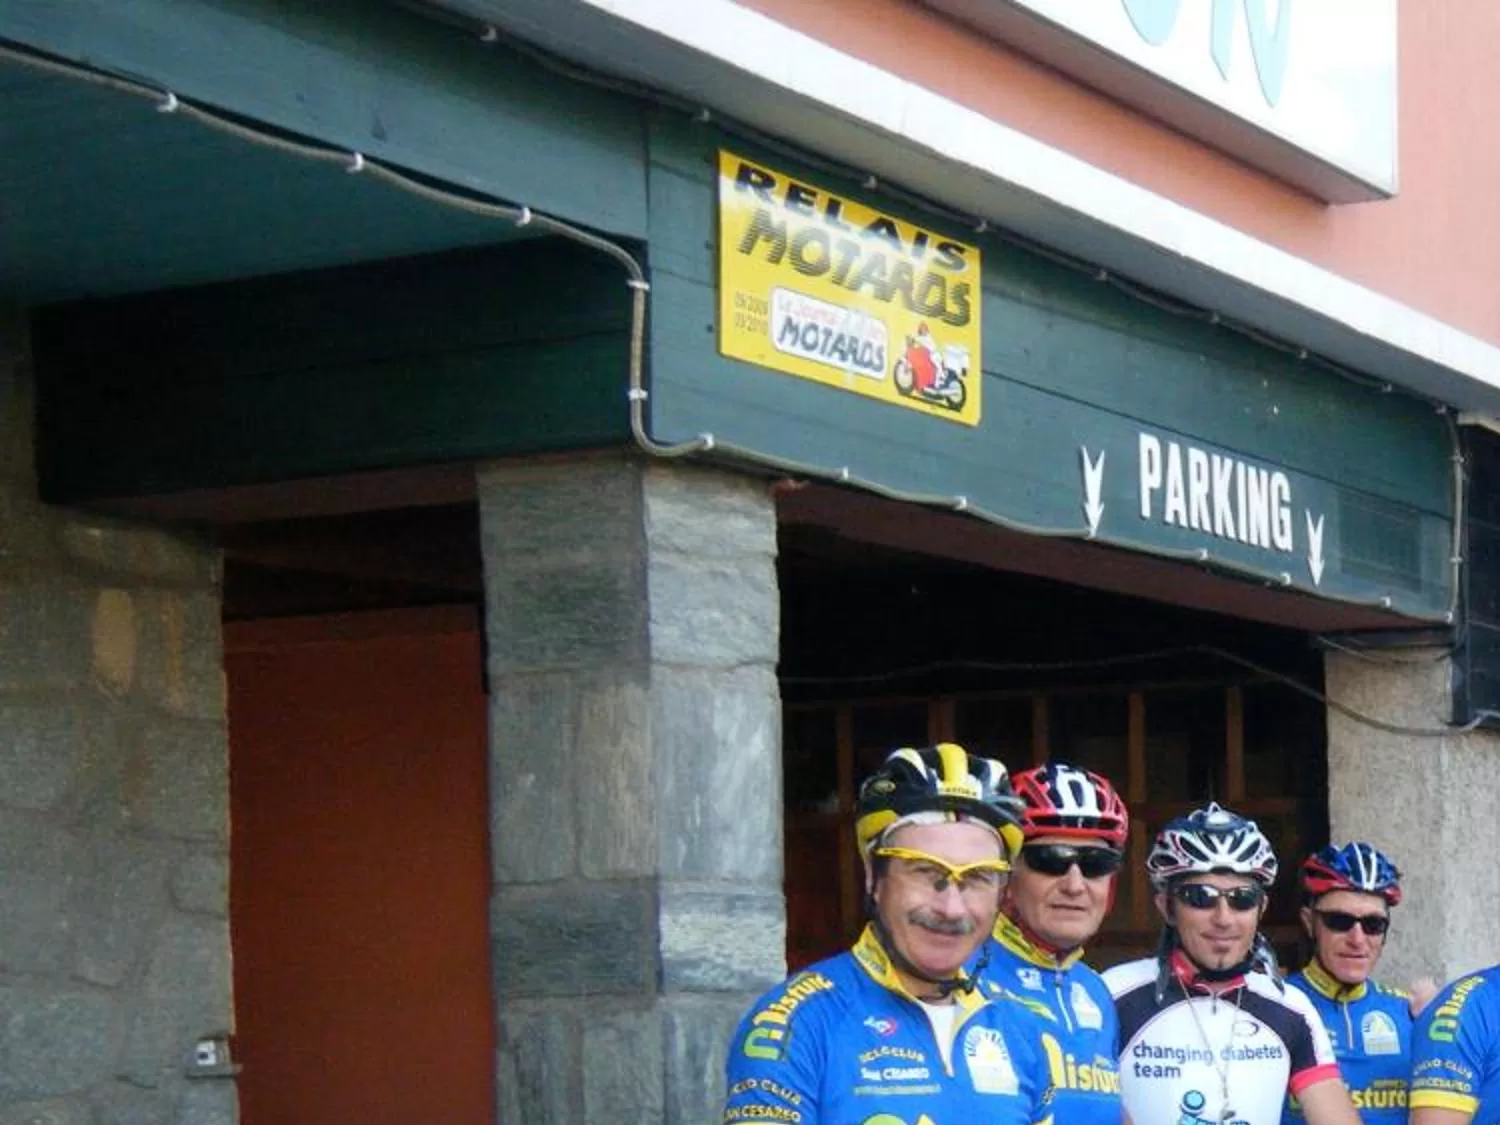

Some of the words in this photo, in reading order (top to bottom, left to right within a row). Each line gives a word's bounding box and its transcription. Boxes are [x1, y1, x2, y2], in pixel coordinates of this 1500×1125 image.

[734, 163, 969, 272] RELAIS
[736, 207, 971, 327] MOTARDS
[777, 315, 885, 372] MOTARDS
[1138, 433, 1294, 553] PARKING
[1133, 1039, 1214, 1067] changing
[1220, 1043, 1283, 1060] diabetes
[1133, 1061, 1181, 1078] team
